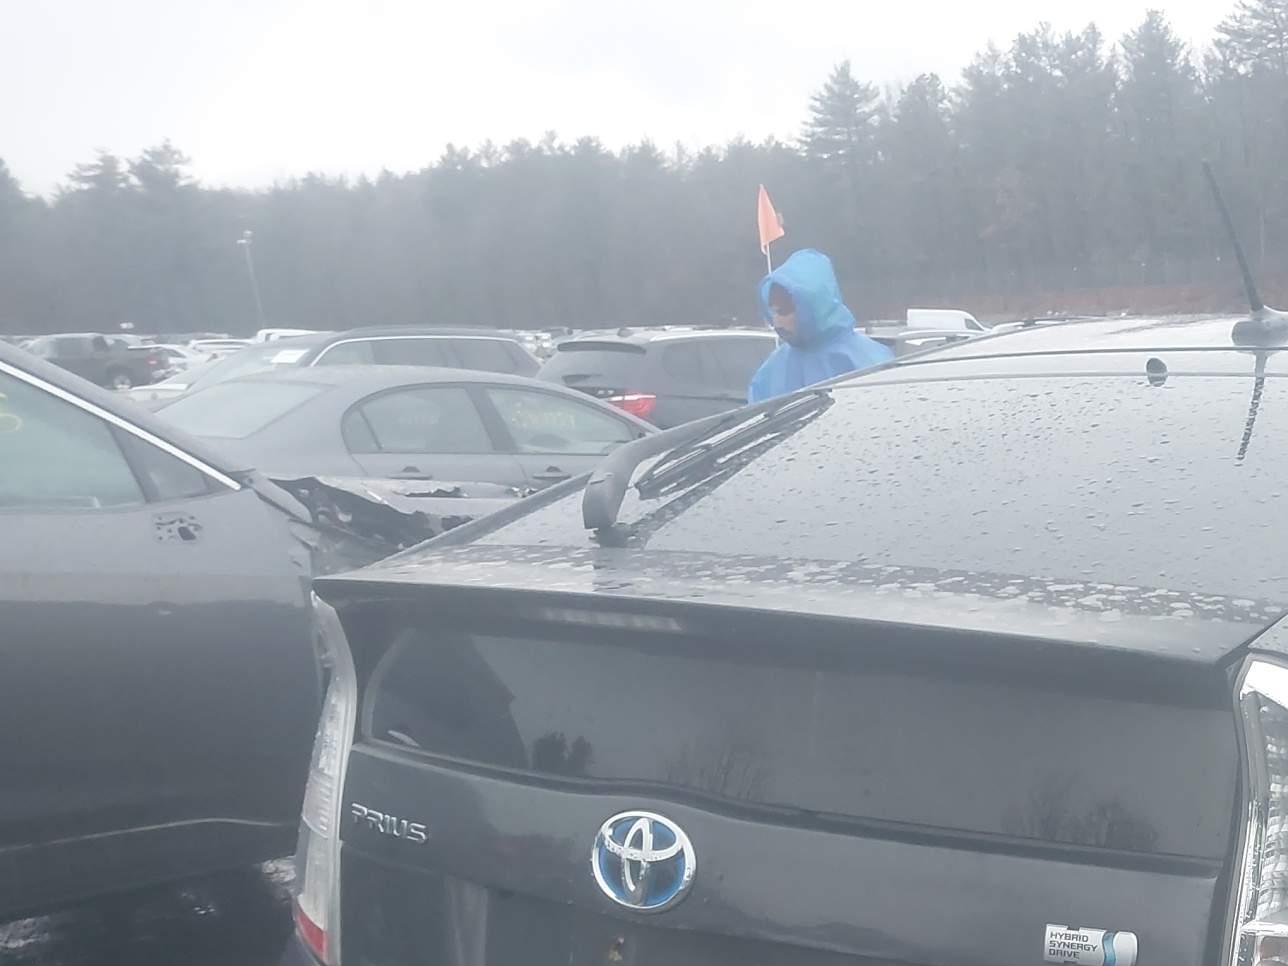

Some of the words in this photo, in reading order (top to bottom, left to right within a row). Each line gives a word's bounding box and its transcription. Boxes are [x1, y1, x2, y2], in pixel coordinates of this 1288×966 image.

[351, 803, 427, 844] PRIUS
[1049, 931, 1089, 943] HYBRID
[1049, 940, 1098, 952] SYNERGY
[1048, 948, 1080, 959] DRIVE
